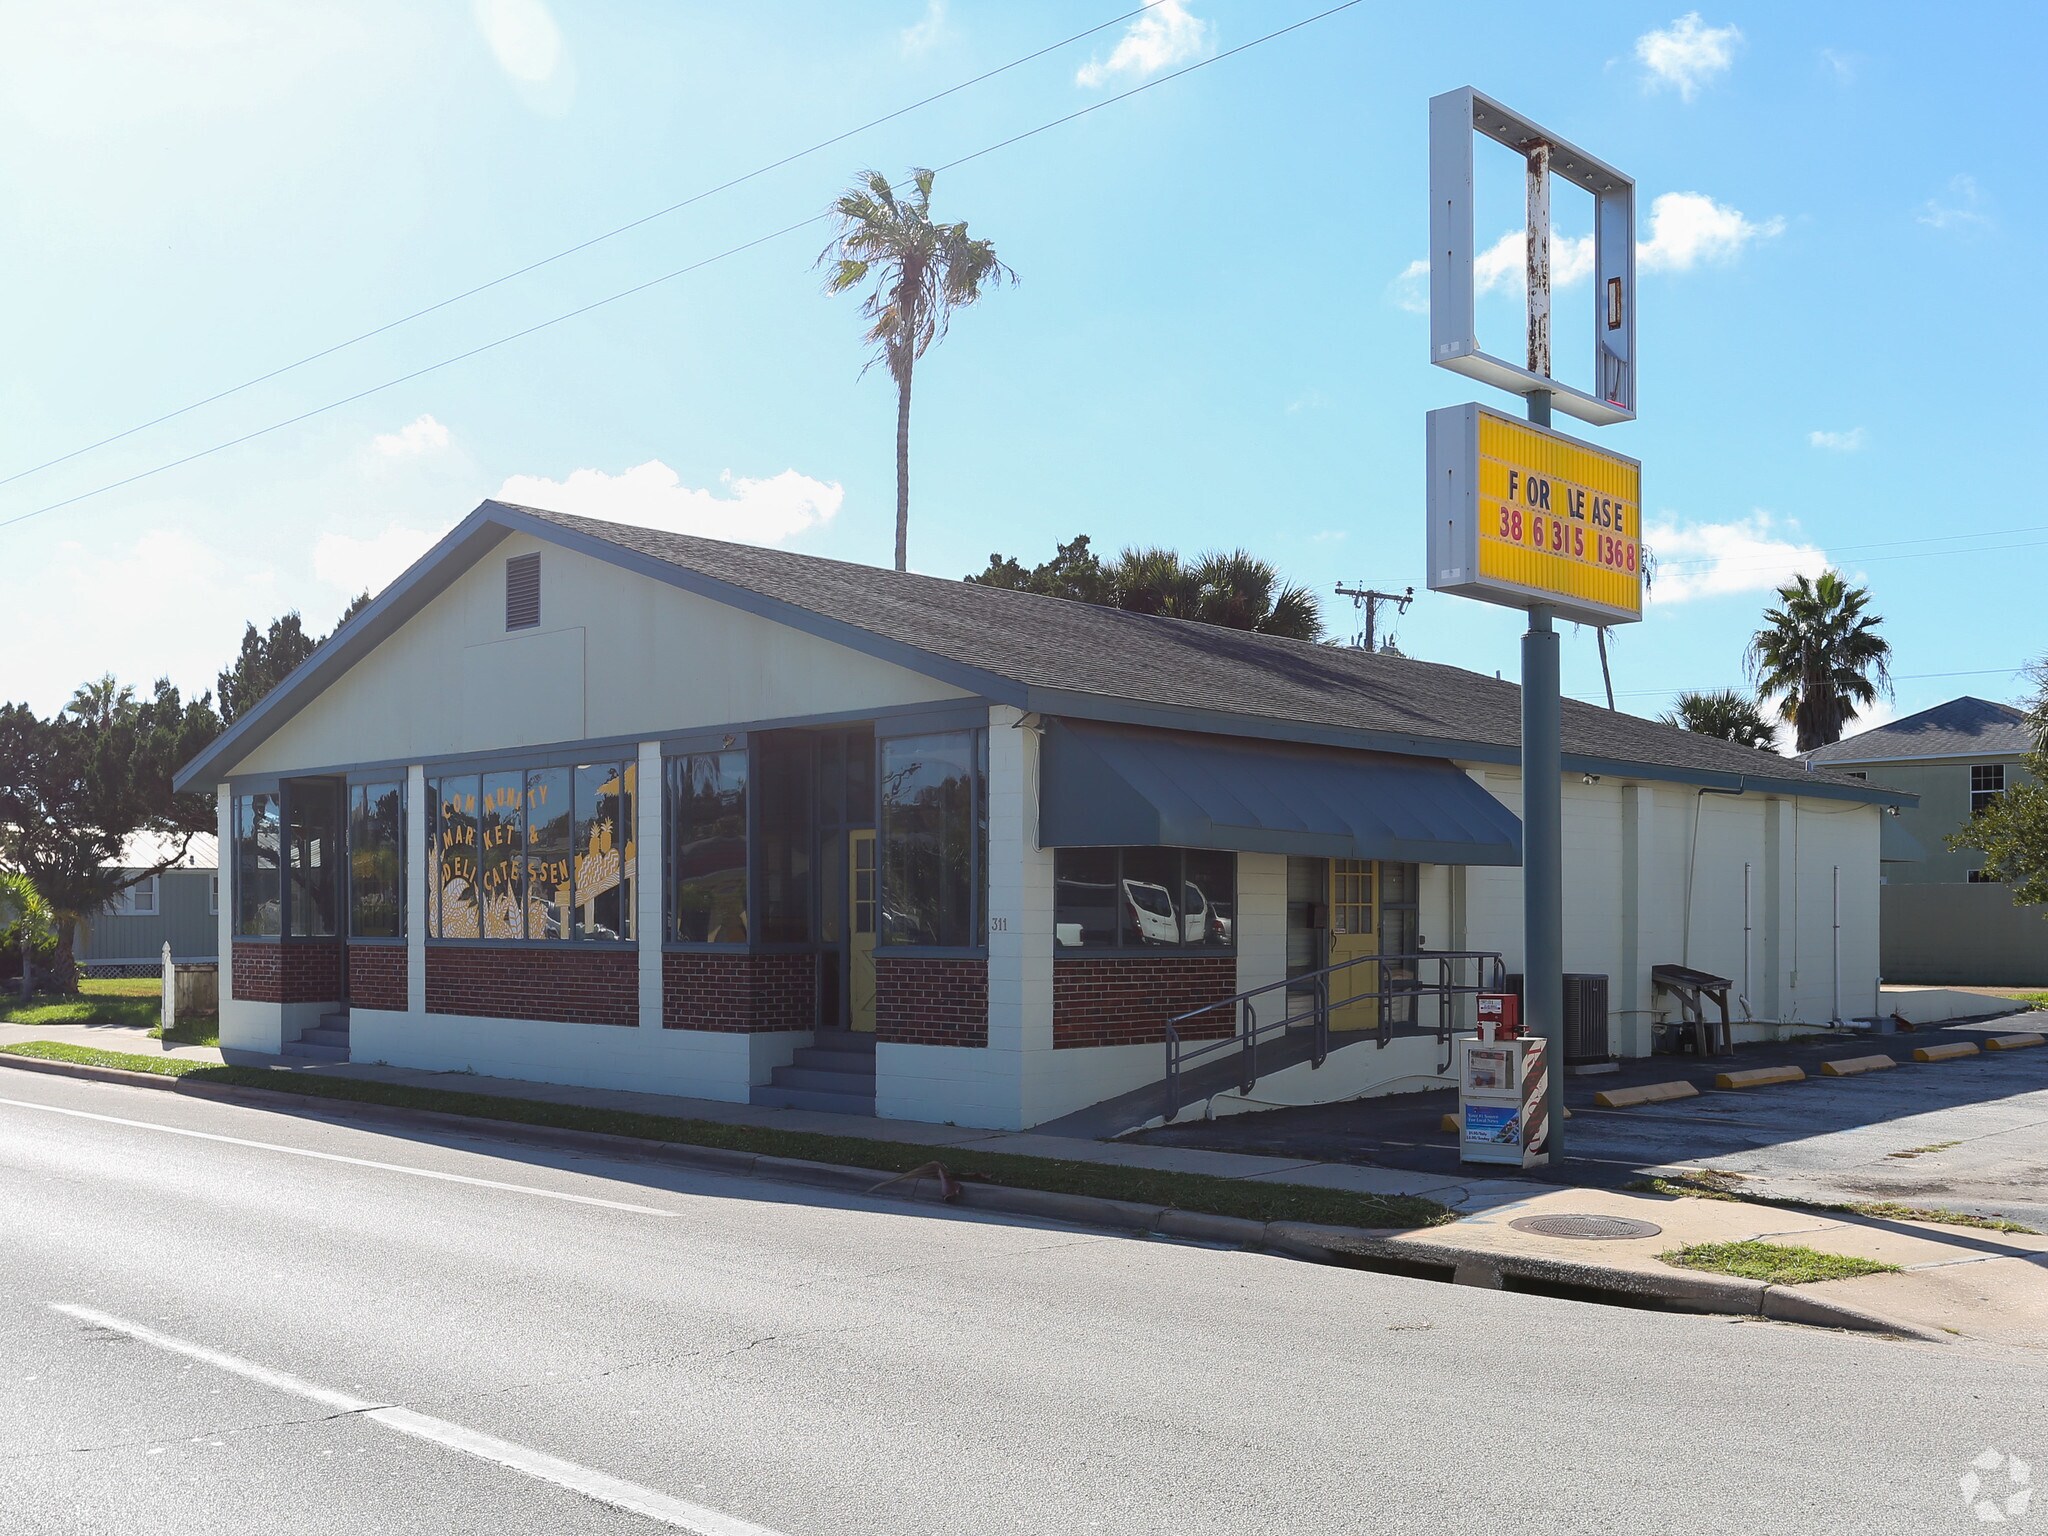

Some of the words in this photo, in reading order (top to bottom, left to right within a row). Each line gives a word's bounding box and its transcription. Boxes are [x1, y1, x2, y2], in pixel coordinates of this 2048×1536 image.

[1508, 470, 1550, 511] FOR
[1567, 488, 1623, 532] LEASE
[1598, 534, 1636, 572] 1368
[442, 784, 548, 819] COMMUNITY
[442, 824, 515, 850] MARKET
[529, 824, 539, 844] &
[442, 856, 569, 890] DELICATESSEN
[991, 917, 1008, 931] 311
